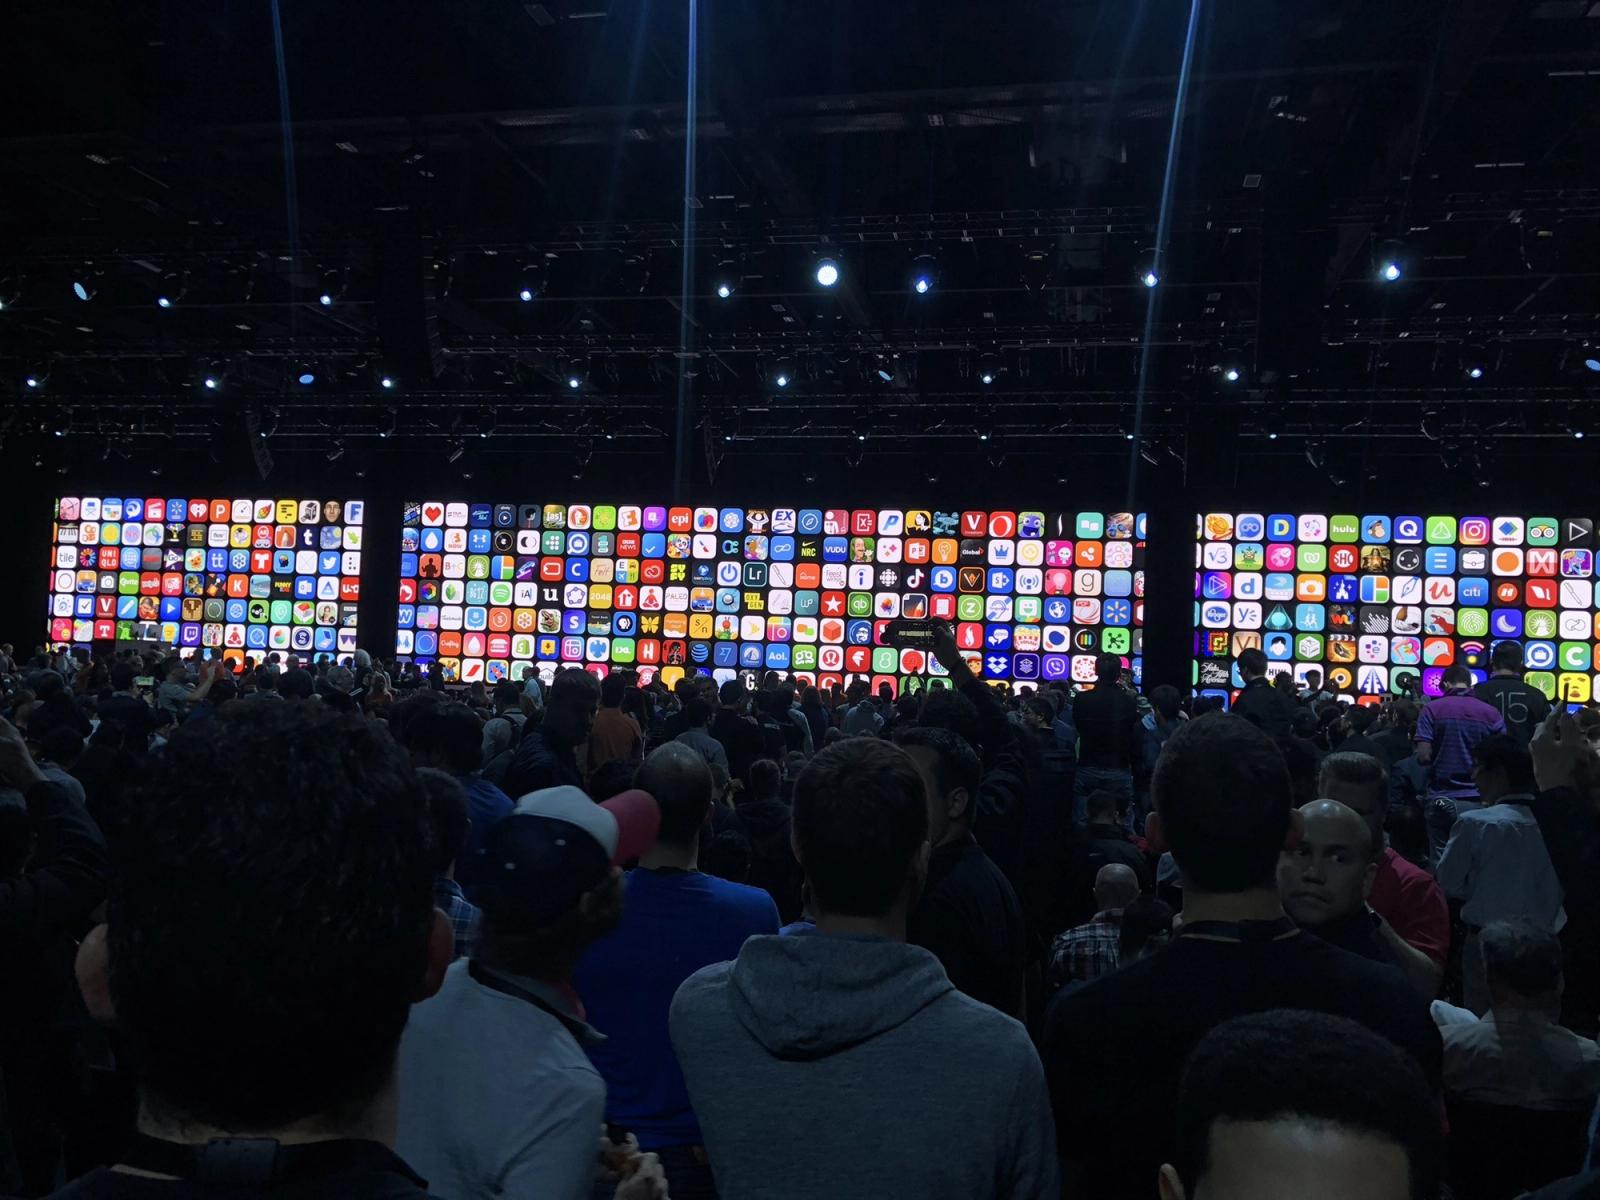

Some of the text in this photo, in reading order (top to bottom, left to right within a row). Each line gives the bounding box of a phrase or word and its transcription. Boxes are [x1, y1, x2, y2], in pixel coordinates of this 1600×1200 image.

[671, 512, 689, 527] epi
[775, 510, 794, 521] EX
[1273, 519, 1290, 536] D
[1332, 524, 1356, 534] hulu
[1399, 519, 1418, 537] Q
[303, 528, 313, 545] t
[102, 550, 117, 558] UNI
[801, 547, 816, 557] NRC
[825, 546, 846, 554] VUDU
[59, 552, 74, 563] tile
[101, 559, 117, 568] QLO
[571, 563, 582, 576] C
[749, 567, 762, 580] Lr
[941, 573, 948, 583] b
[1081, 572, 1095, 593] g
[233, 579, 242, 593] K
[1240, 577, 1255, 594] d
[1463, 586, 1481, 597] citi
[542, 588, 559, 602] u
[569, 615, 579, 629] S
[99, 624, 110, 637] T
[768, 651, 788, 661] Aol.
[1565, 646, 1584, 666] C
[1495, 691, 1529, 723] 15
